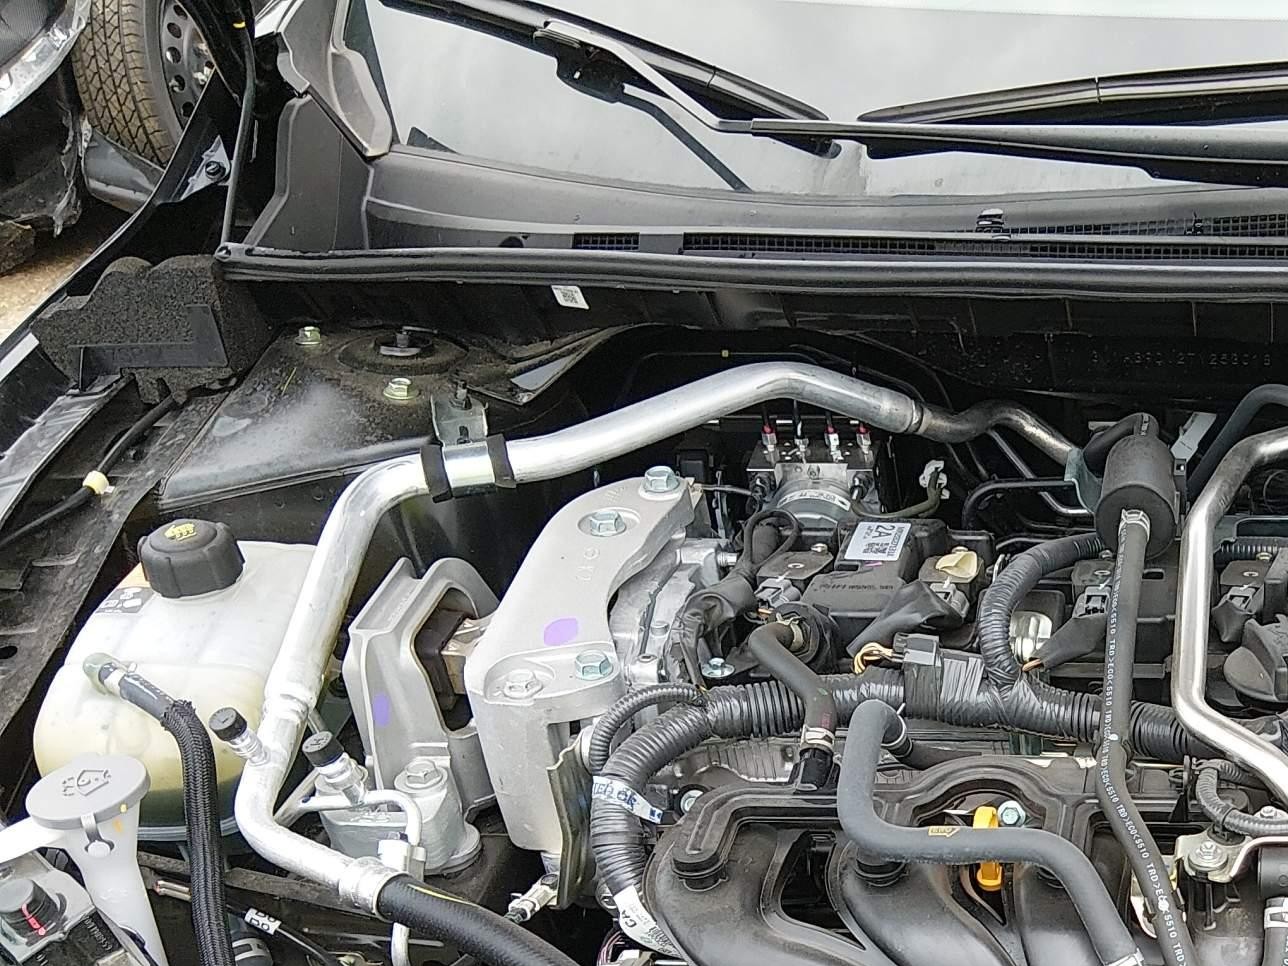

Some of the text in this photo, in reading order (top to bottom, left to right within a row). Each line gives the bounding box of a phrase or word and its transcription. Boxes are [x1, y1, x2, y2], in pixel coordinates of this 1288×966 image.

[871, 524, 895, 540] 2A
[1145, 863, 1178, 939] TRD>E<5510
[620, 909, 638, 928] CA
